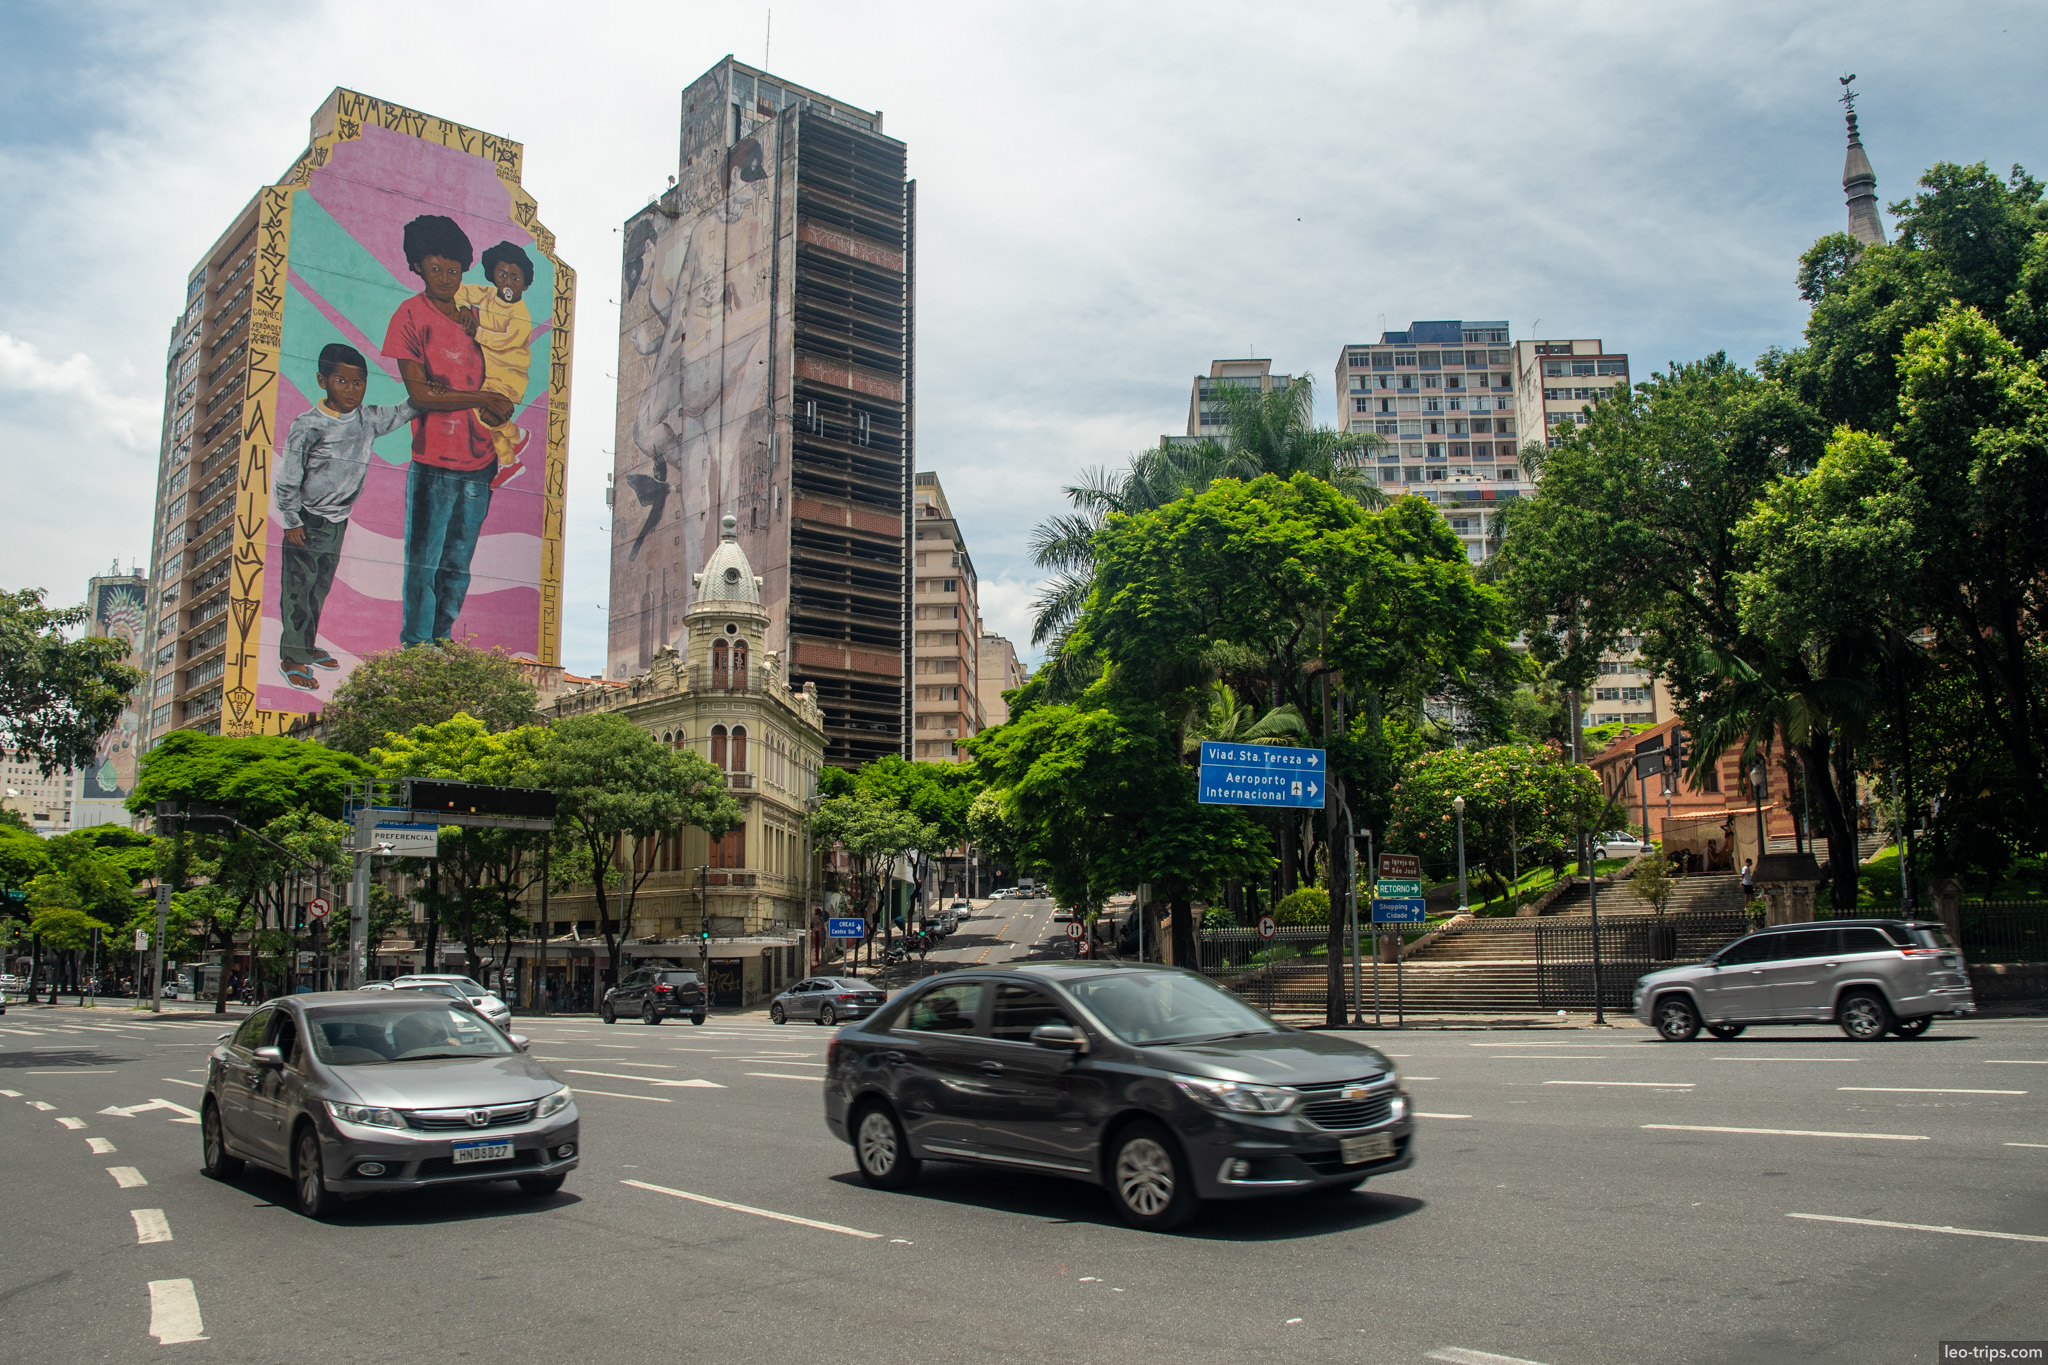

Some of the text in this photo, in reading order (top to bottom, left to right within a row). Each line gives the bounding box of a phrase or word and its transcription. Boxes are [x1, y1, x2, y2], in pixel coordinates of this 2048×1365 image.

[1209, 748, 1301, 764] Viad. Sta. Tereza
[1225, 772, 1285, 785] Aeroporto
[1206, 787, 1285, 800] Internacional
[375, 833, 434, 841] PREFERENCIAL
[1380, 885, 1410, 893] RETORNO
[460, 1145, 508, 1161] HND8D27
